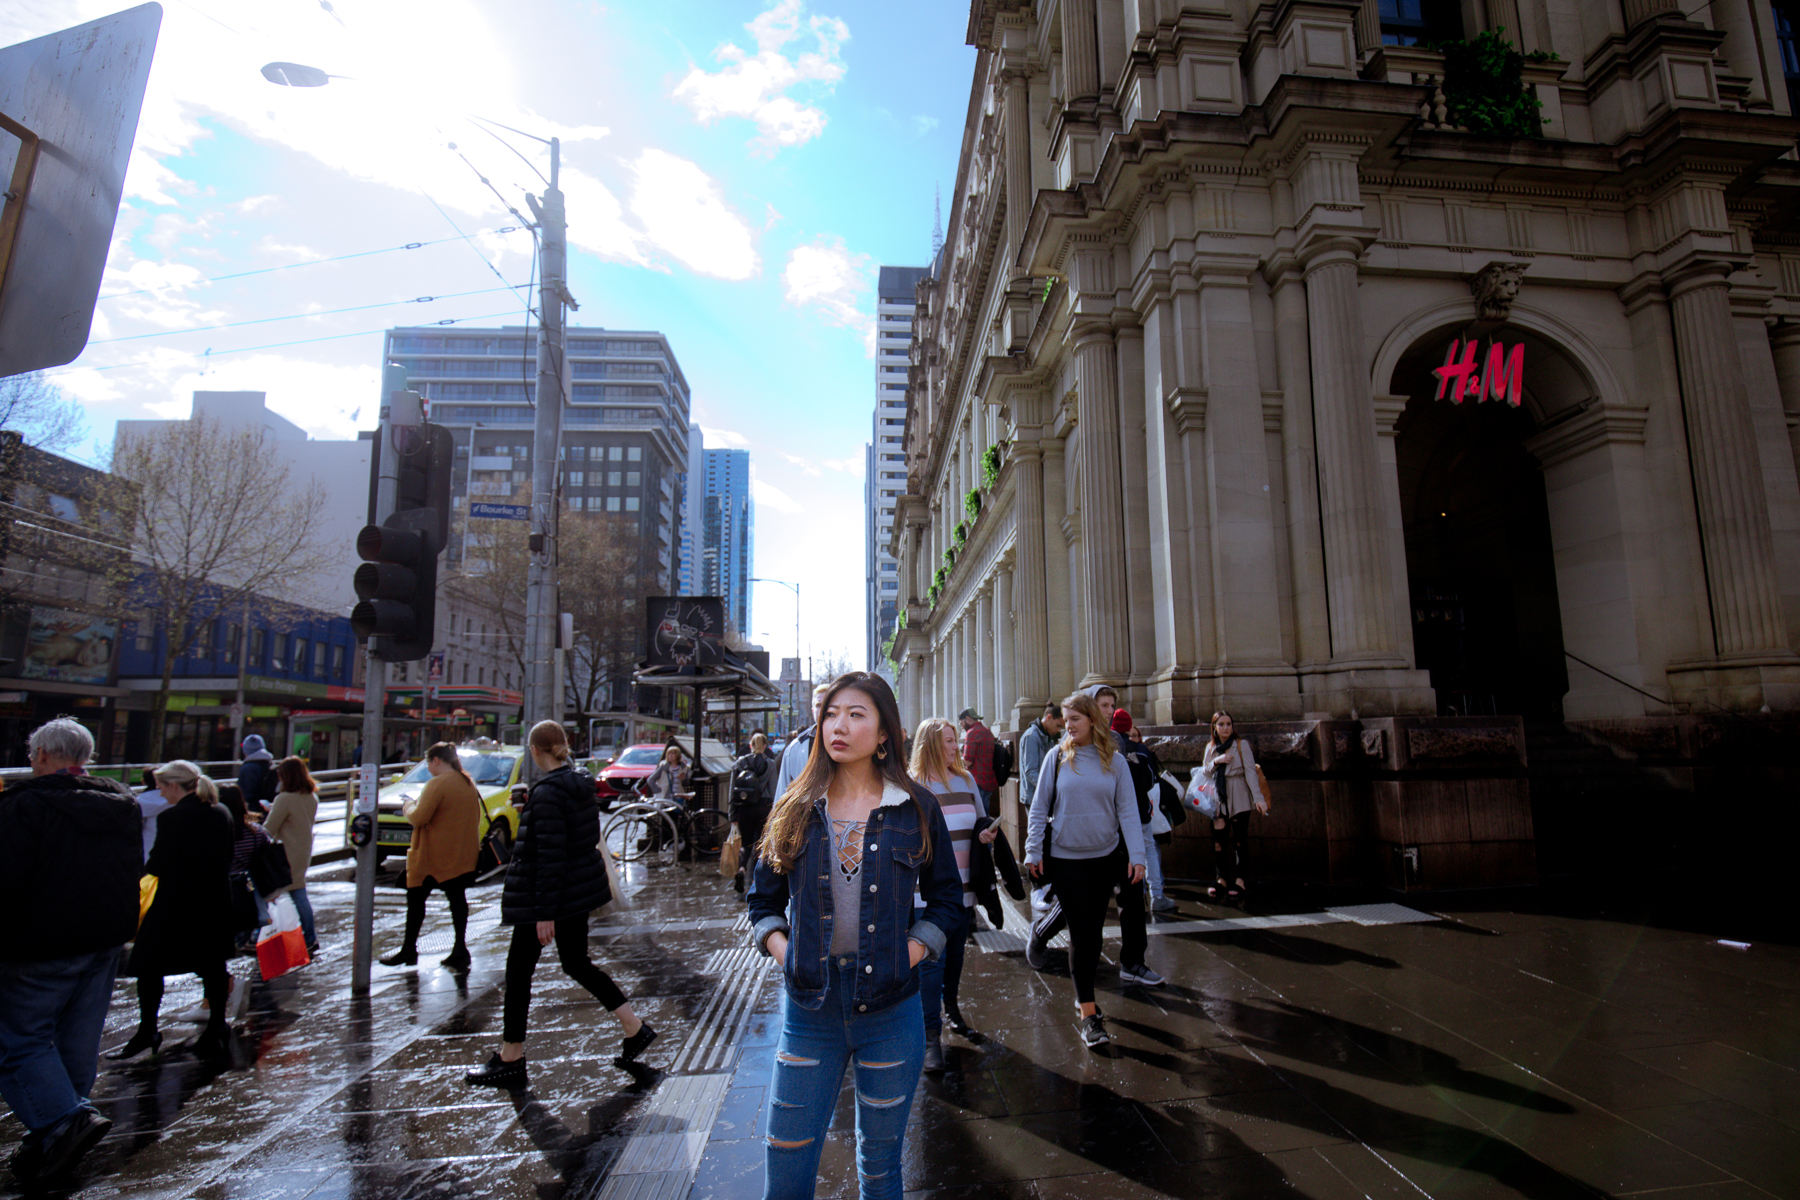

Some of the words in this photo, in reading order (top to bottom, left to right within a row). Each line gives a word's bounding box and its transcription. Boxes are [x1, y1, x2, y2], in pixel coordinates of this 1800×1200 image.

[1431, 338, 1525, 408] H&M
[480, 504, 514, 515] Bourke
[516, 507, 527, 516] St
